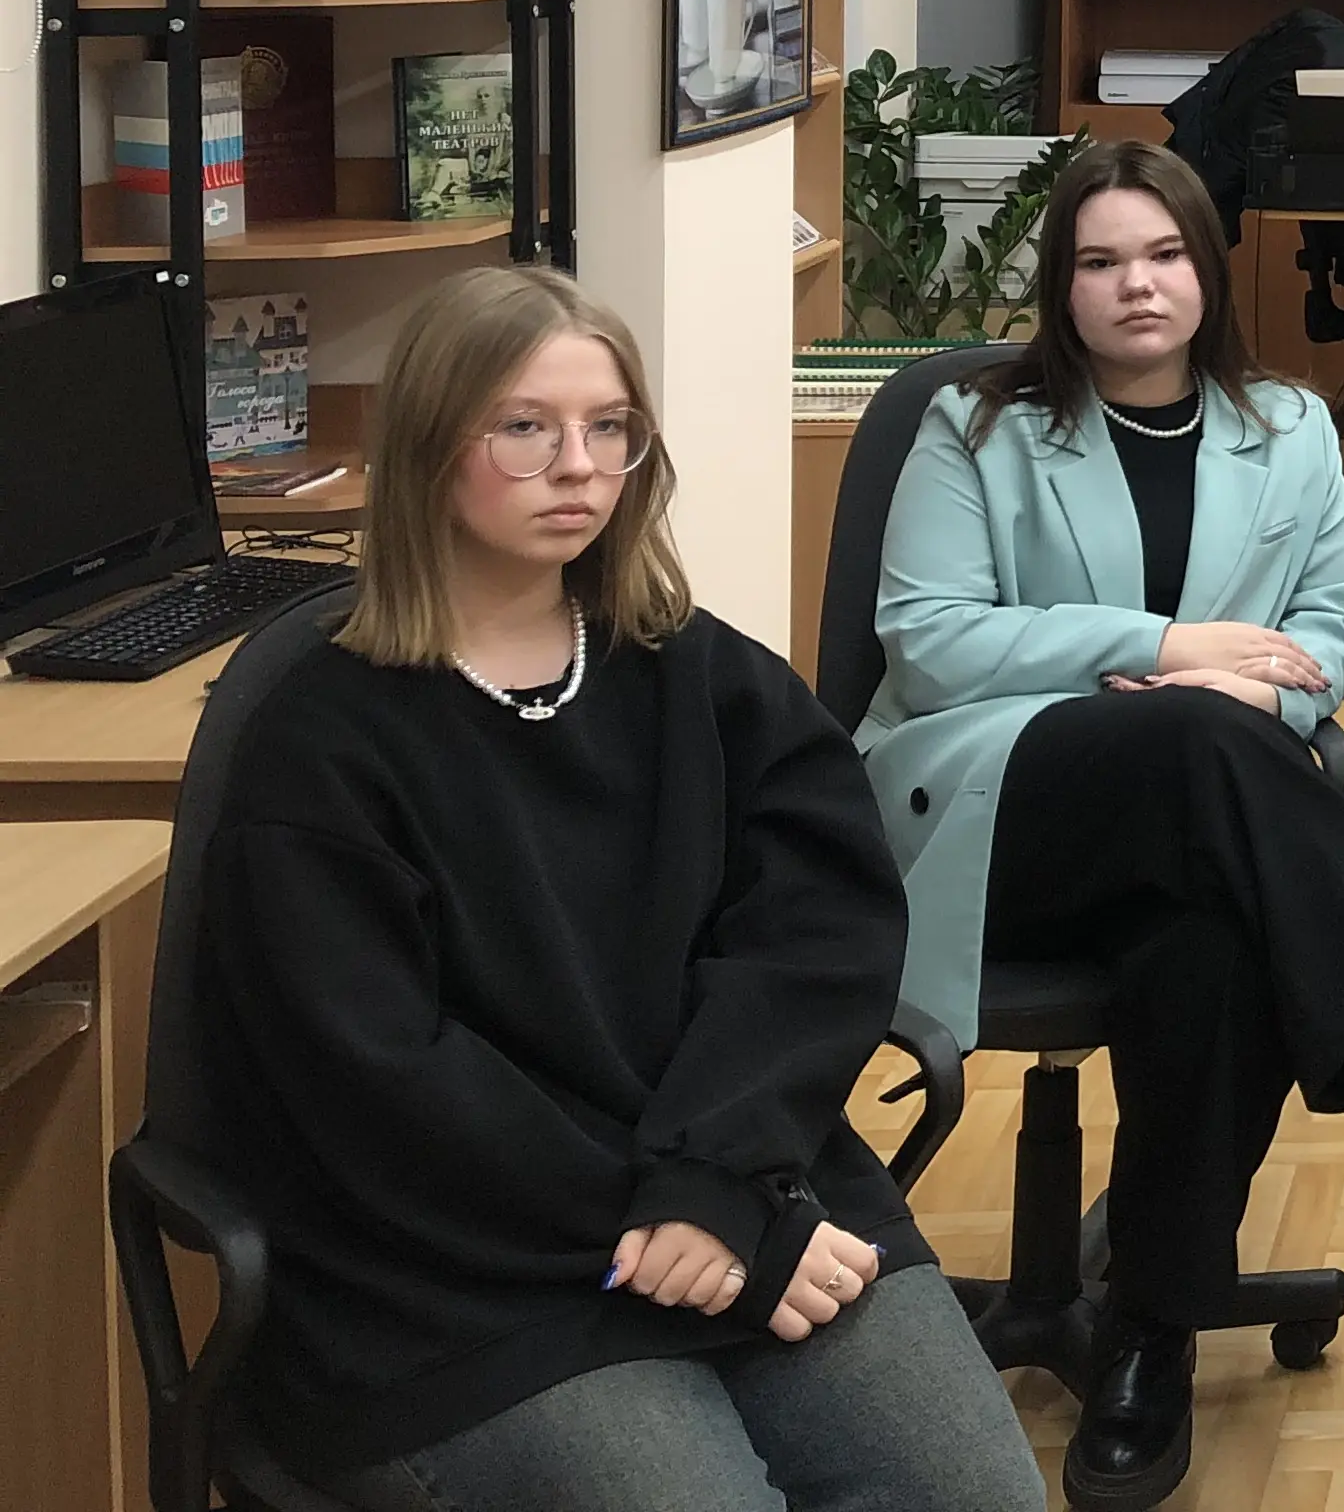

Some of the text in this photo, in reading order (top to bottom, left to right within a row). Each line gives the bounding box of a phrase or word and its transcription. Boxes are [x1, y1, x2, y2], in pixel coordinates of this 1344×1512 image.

[450, 109, 480, 121] НЕТ
[419, 122, 512, 137] МАЛЕНЬКИХ
[431, 136, 499, 150] ТЕАТРОВ
